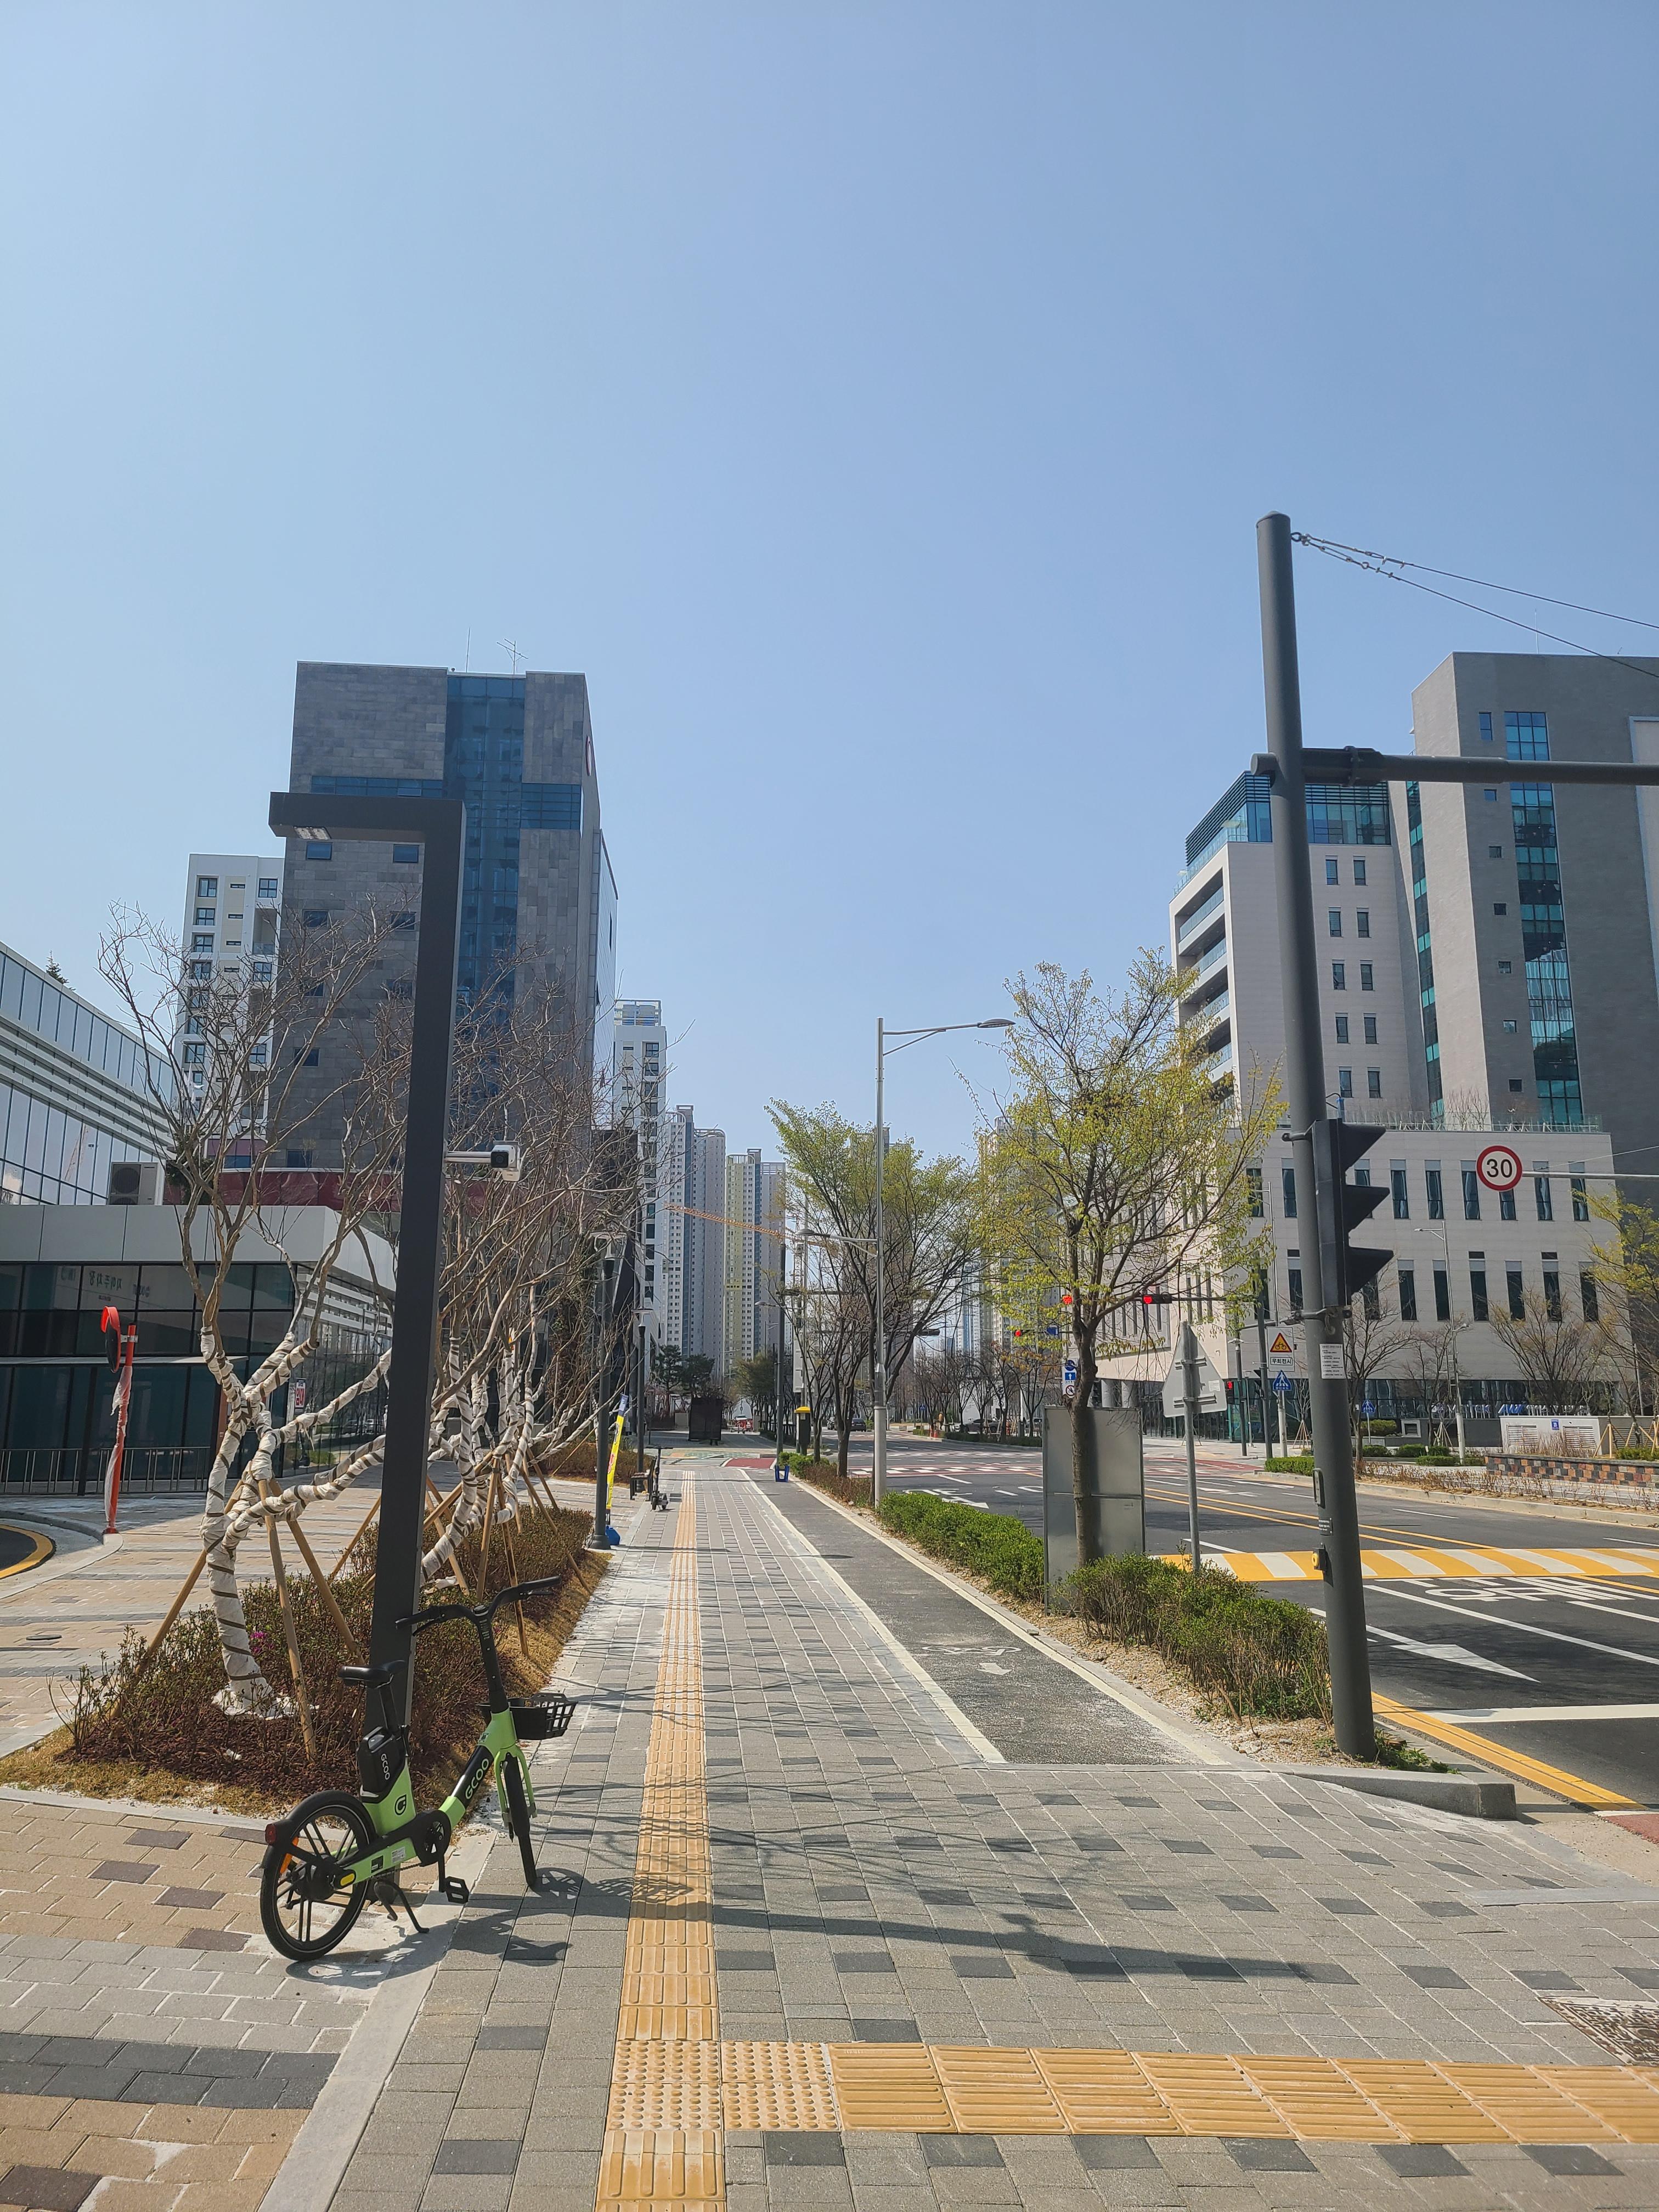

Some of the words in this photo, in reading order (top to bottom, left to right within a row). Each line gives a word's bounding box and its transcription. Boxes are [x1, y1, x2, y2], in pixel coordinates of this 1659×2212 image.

[1486, 1158, 1513, 1178] 30
[381, 1753, 390, 1780] GCOO
[465, 1758, 489, 1799] GCOO
